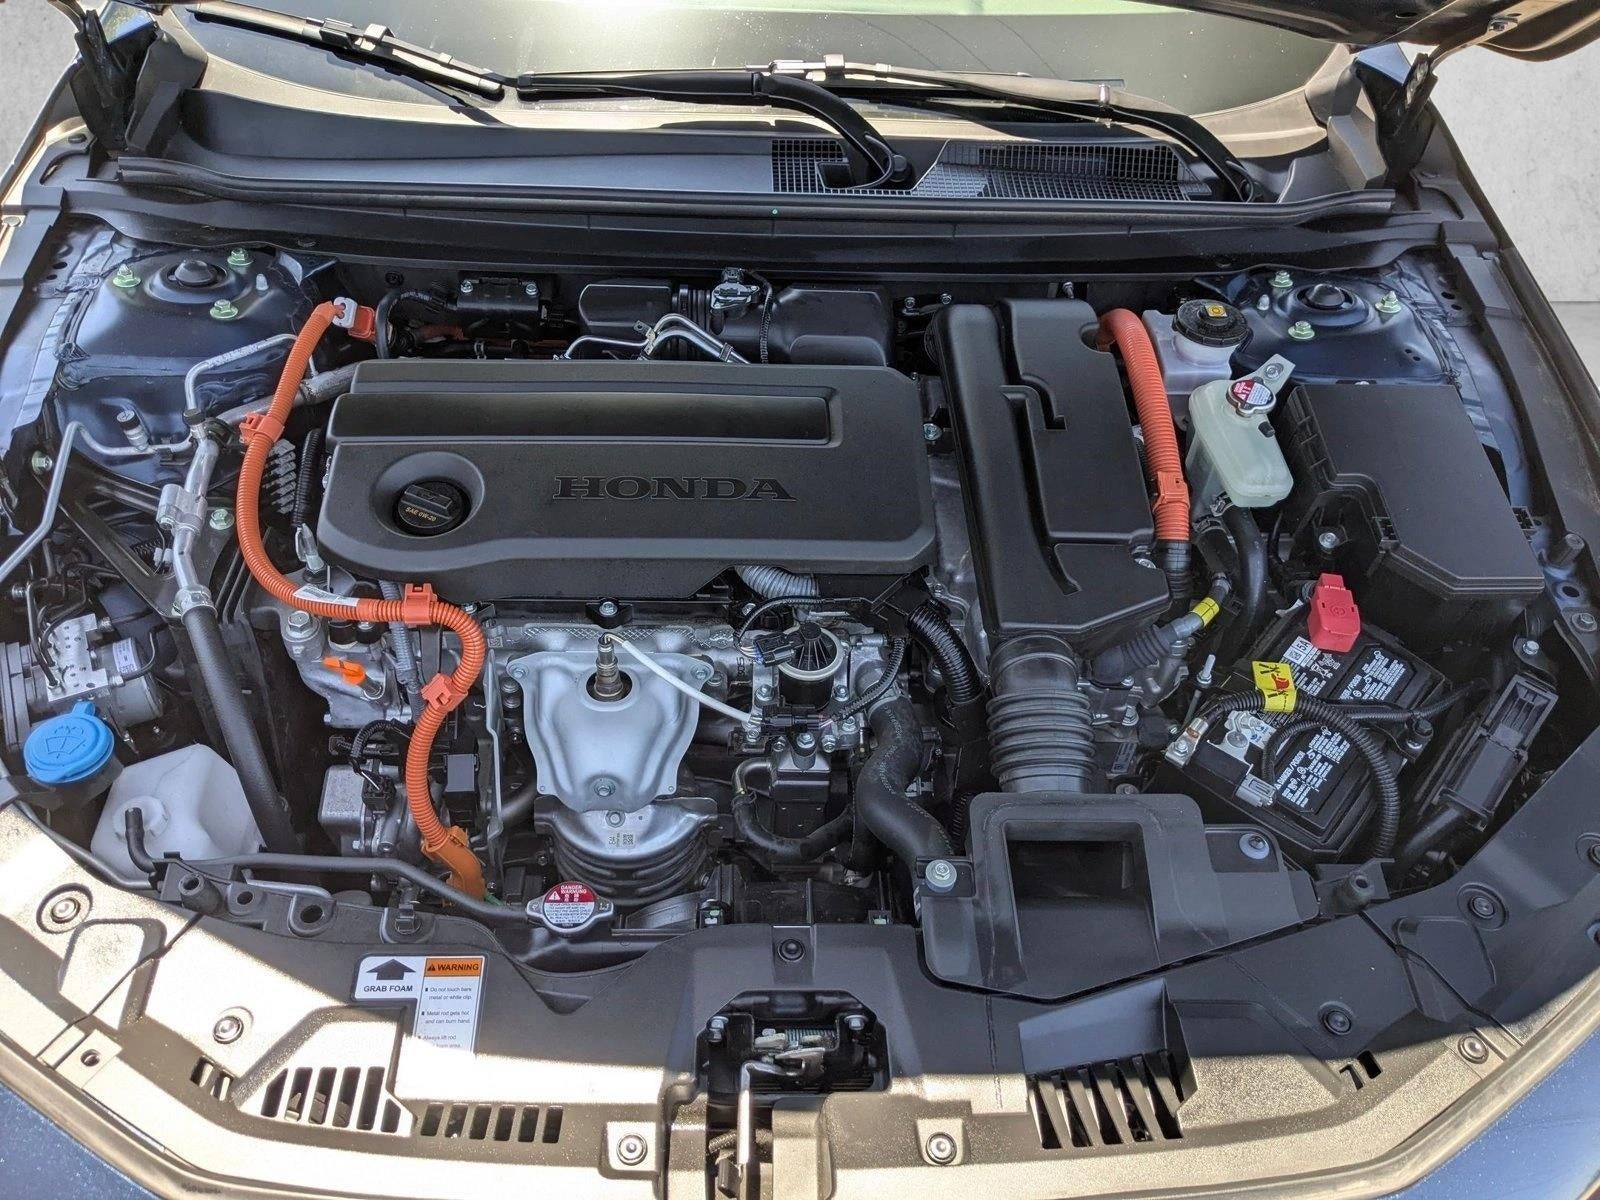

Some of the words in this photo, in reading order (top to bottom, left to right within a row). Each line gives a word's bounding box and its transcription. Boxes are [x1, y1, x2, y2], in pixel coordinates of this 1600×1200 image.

[552, 475, 797, 502] HONDA
[405, 506, 418, 516] SAE
[418, 511, 437, 522] 0W-20
[437, 963, 479, 971] WARNING
